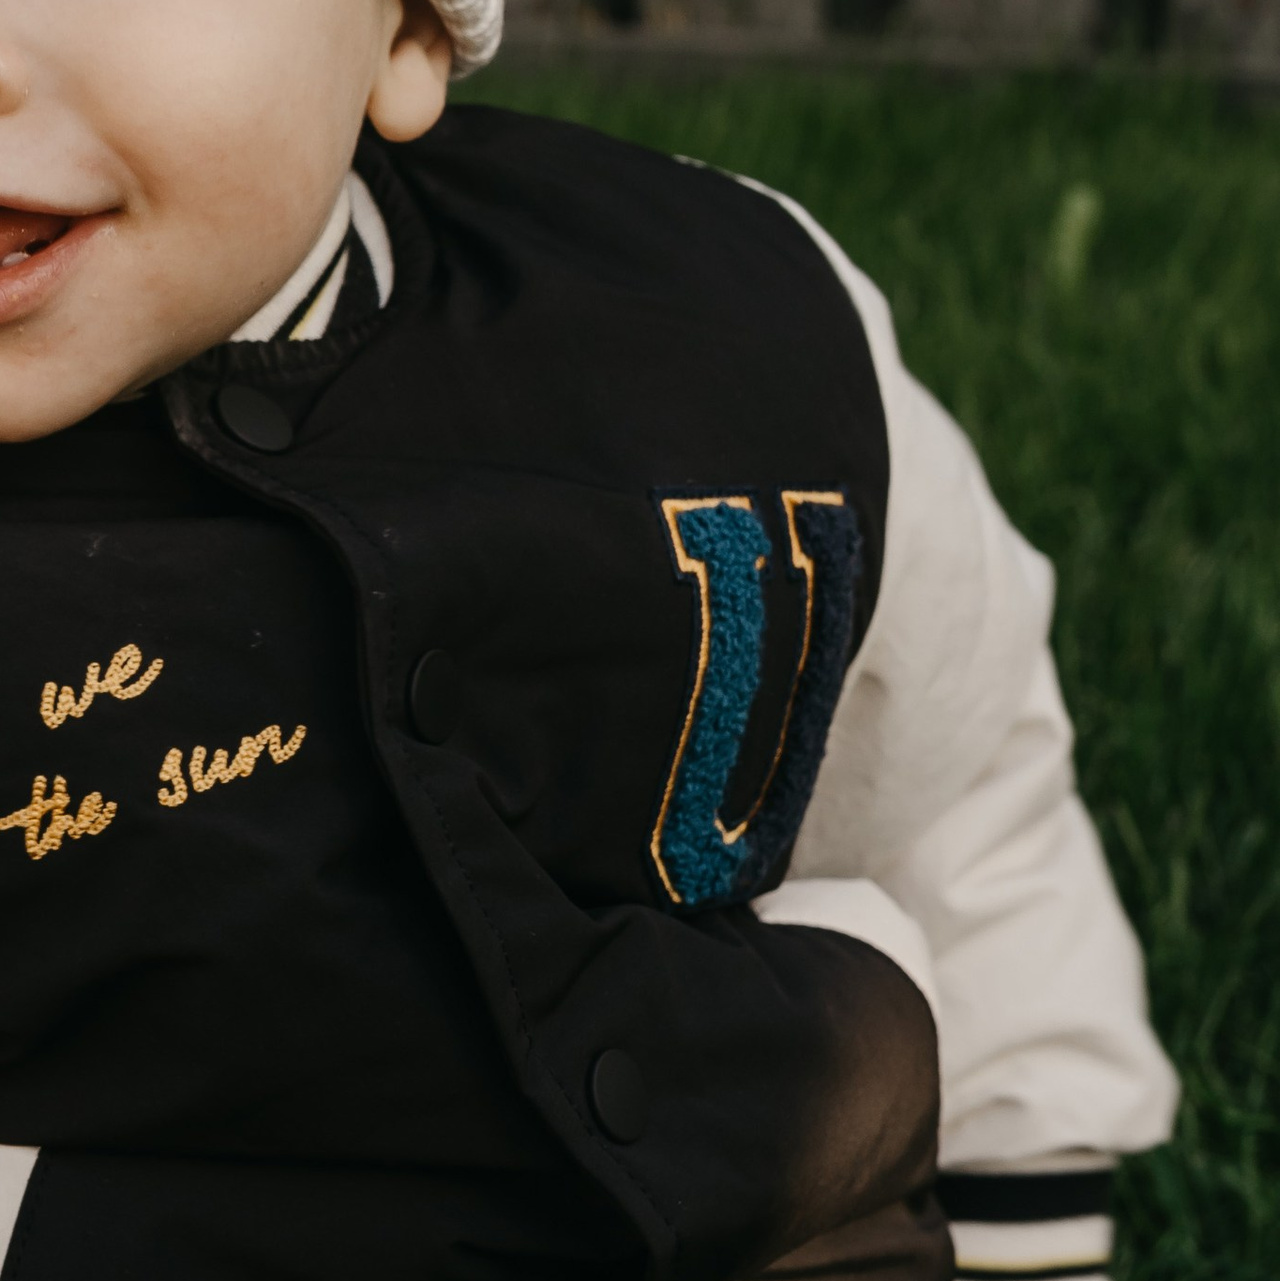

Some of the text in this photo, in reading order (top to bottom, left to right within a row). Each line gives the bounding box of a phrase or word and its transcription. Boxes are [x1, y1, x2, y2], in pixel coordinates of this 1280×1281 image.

[40, 644, 163, 729] we
[651, 486, 864, 910] U
[158, 725, 306, 807] sun
